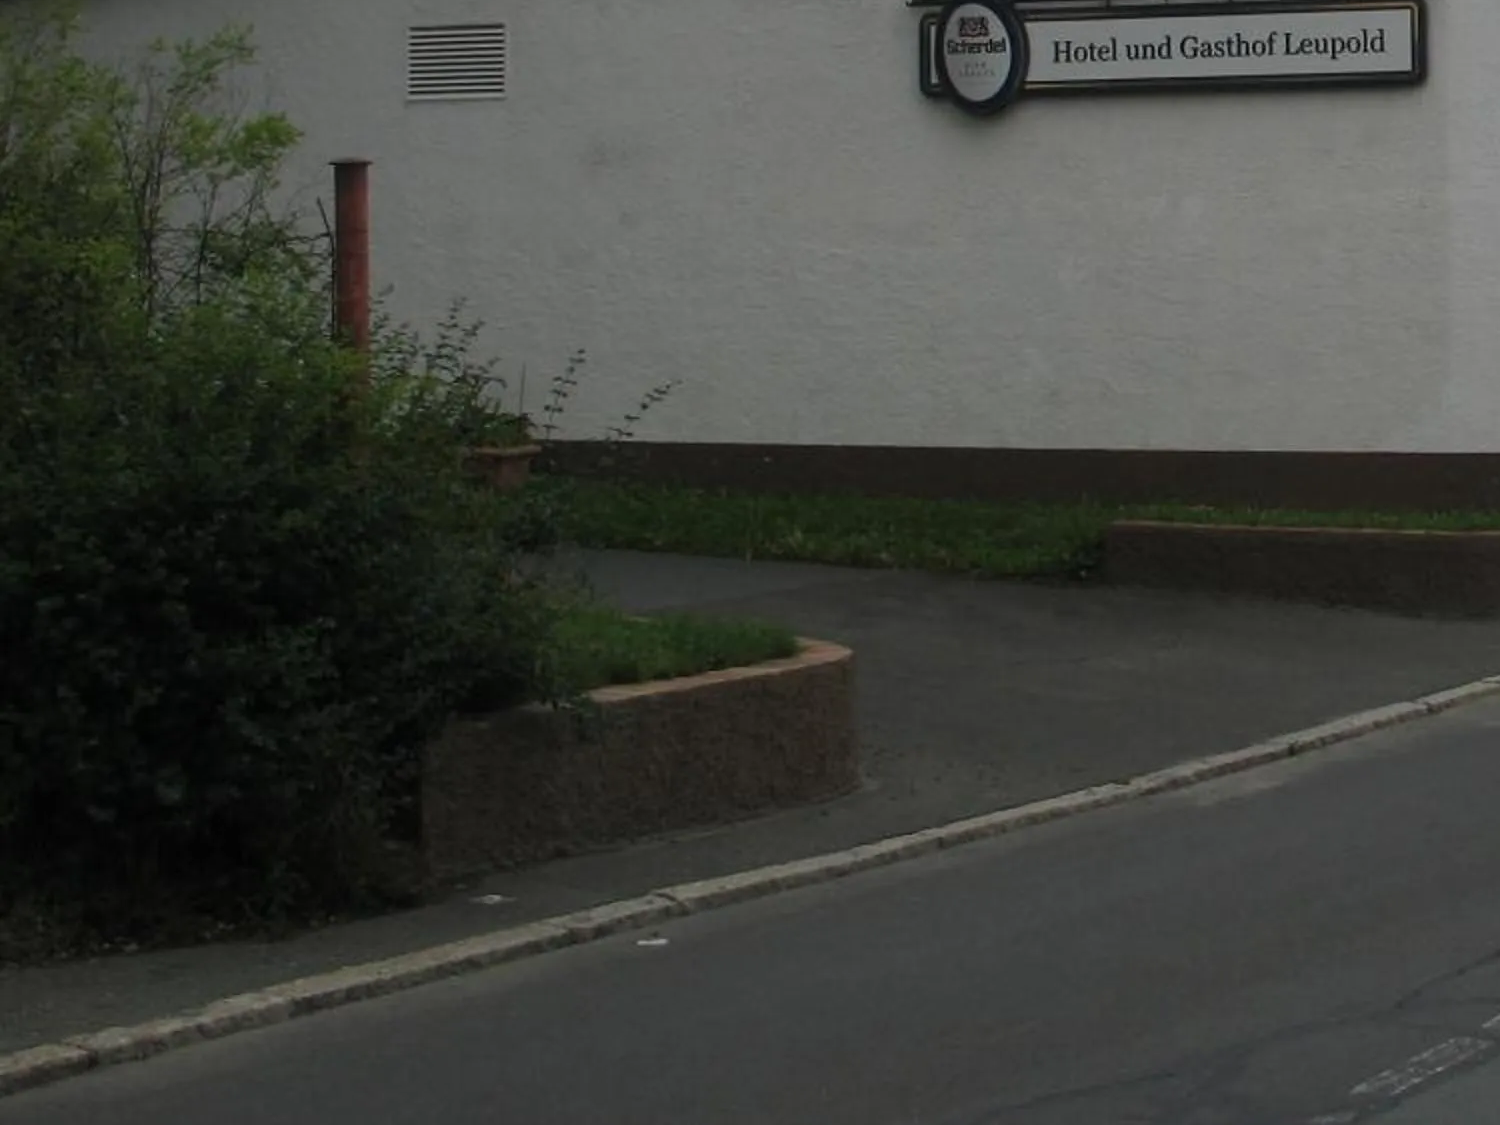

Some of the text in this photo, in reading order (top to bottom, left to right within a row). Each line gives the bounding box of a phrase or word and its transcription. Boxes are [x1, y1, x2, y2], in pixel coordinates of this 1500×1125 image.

[1053, 28, 1385, 63] Hotel und Gasthof Leupold
